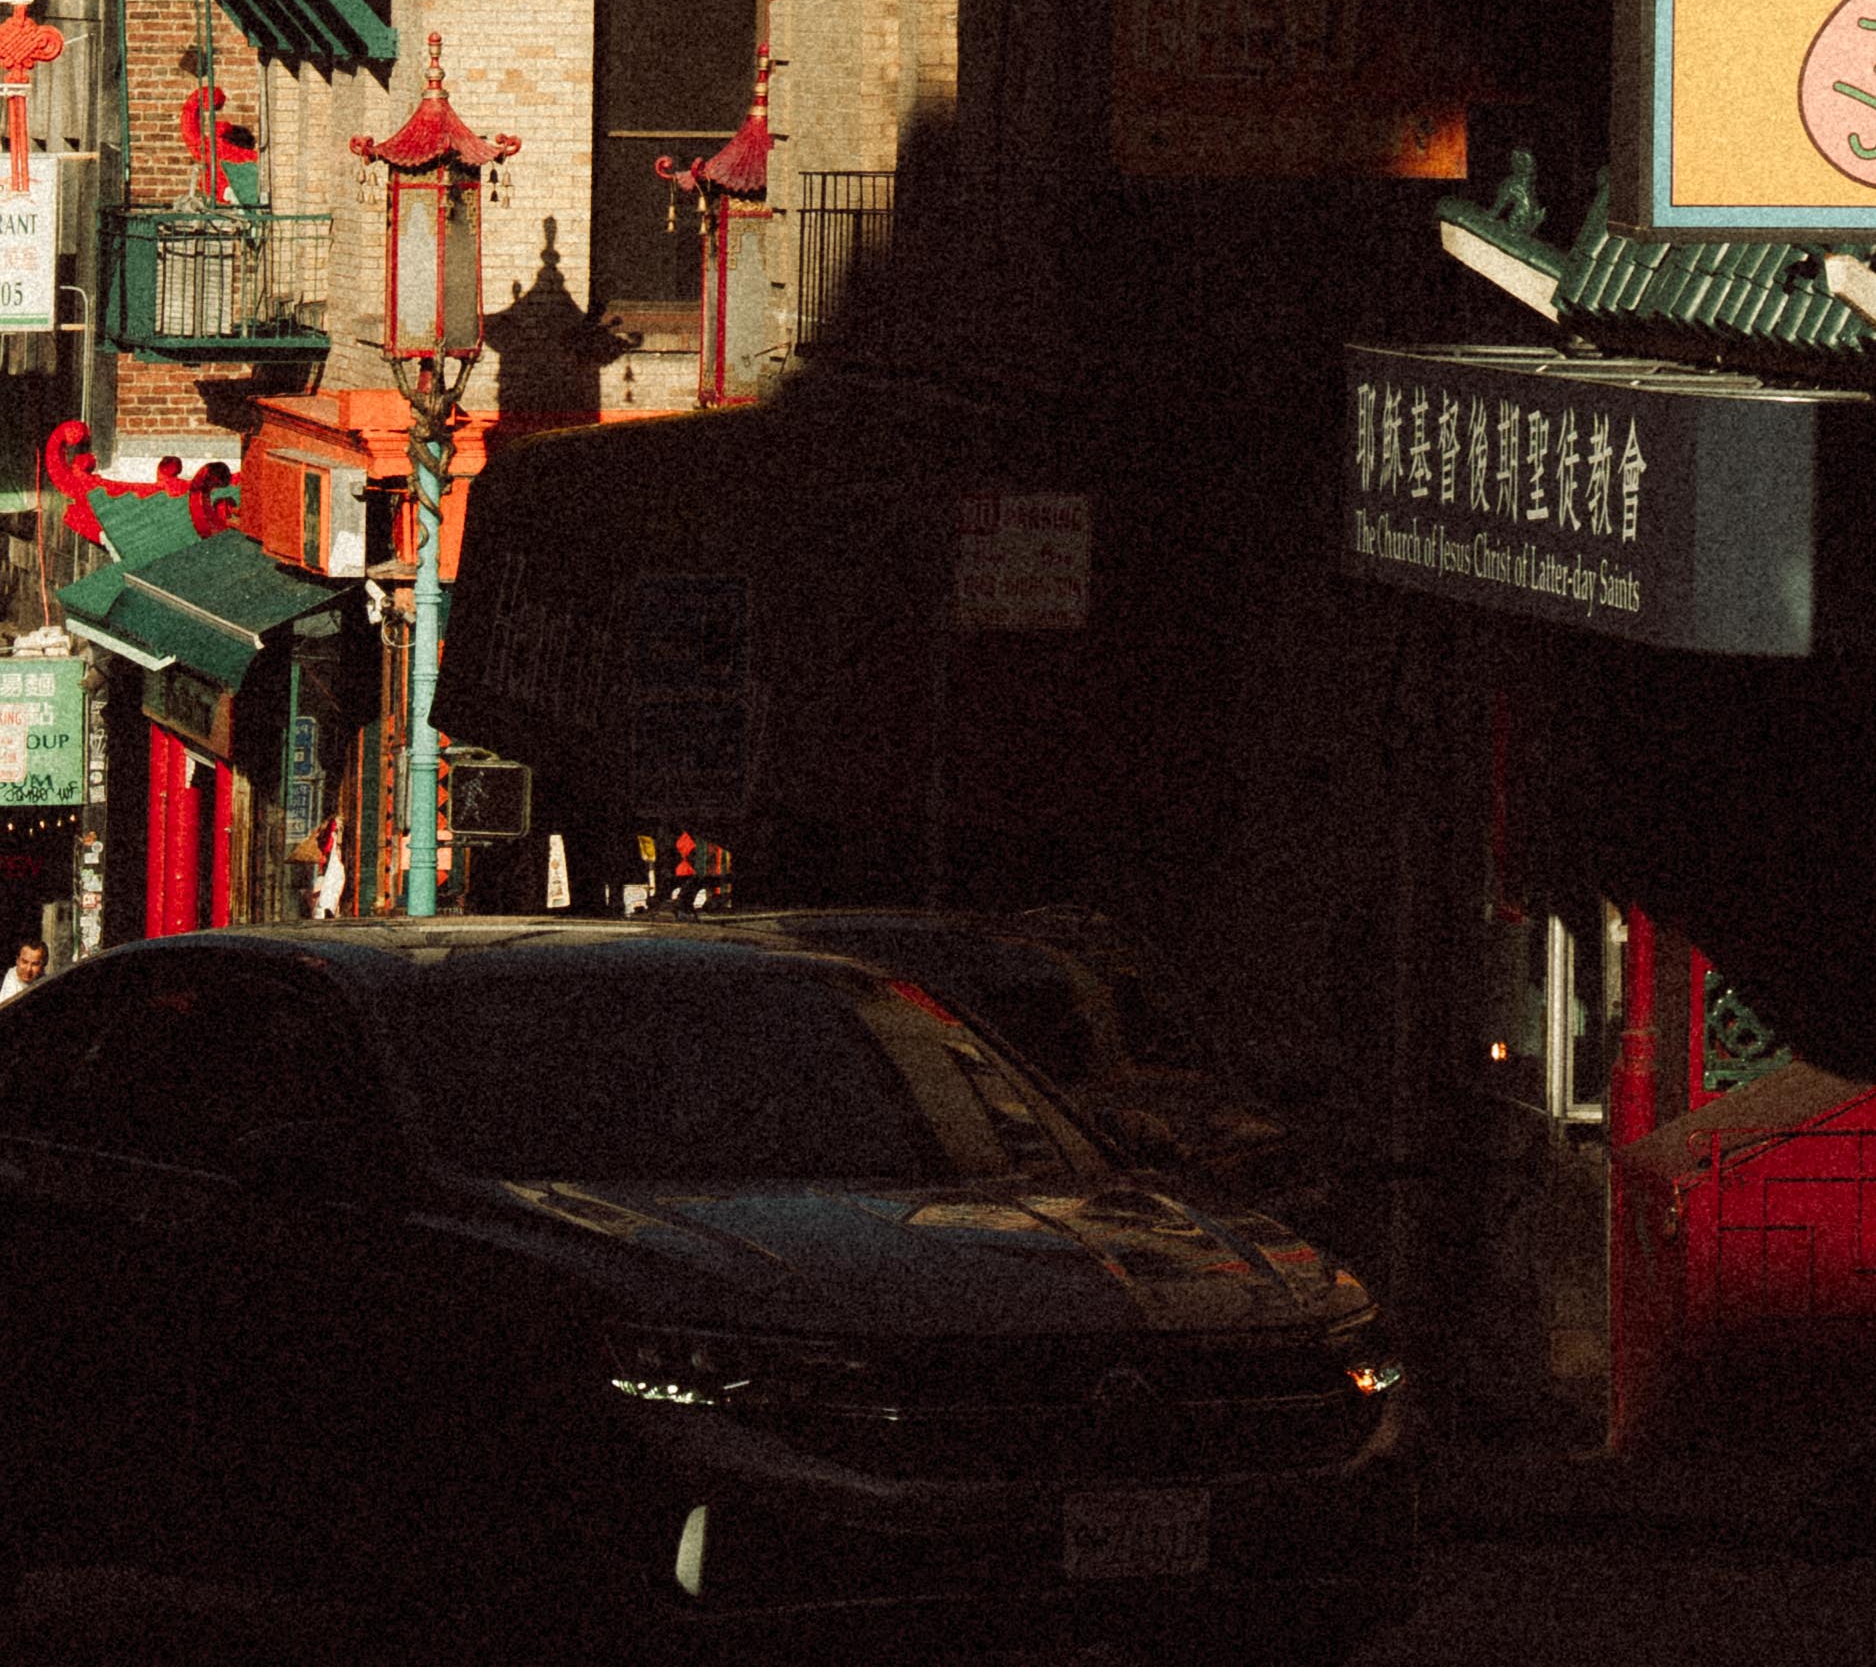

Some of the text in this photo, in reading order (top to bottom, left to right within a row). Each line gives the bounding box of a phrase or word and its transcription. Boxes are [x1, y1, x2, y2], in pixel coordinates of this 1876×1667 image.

[0, 214, 37, 235] ANT
[0, 281, 24, 307] 05
[1356, 383, 1647, 544] 耶穌基督後期聖徒教會
[1356, 508, 1640, 618] The Church of Jesus Christ of Latter-day Saints
[27, 734, 70, 750] OUP
